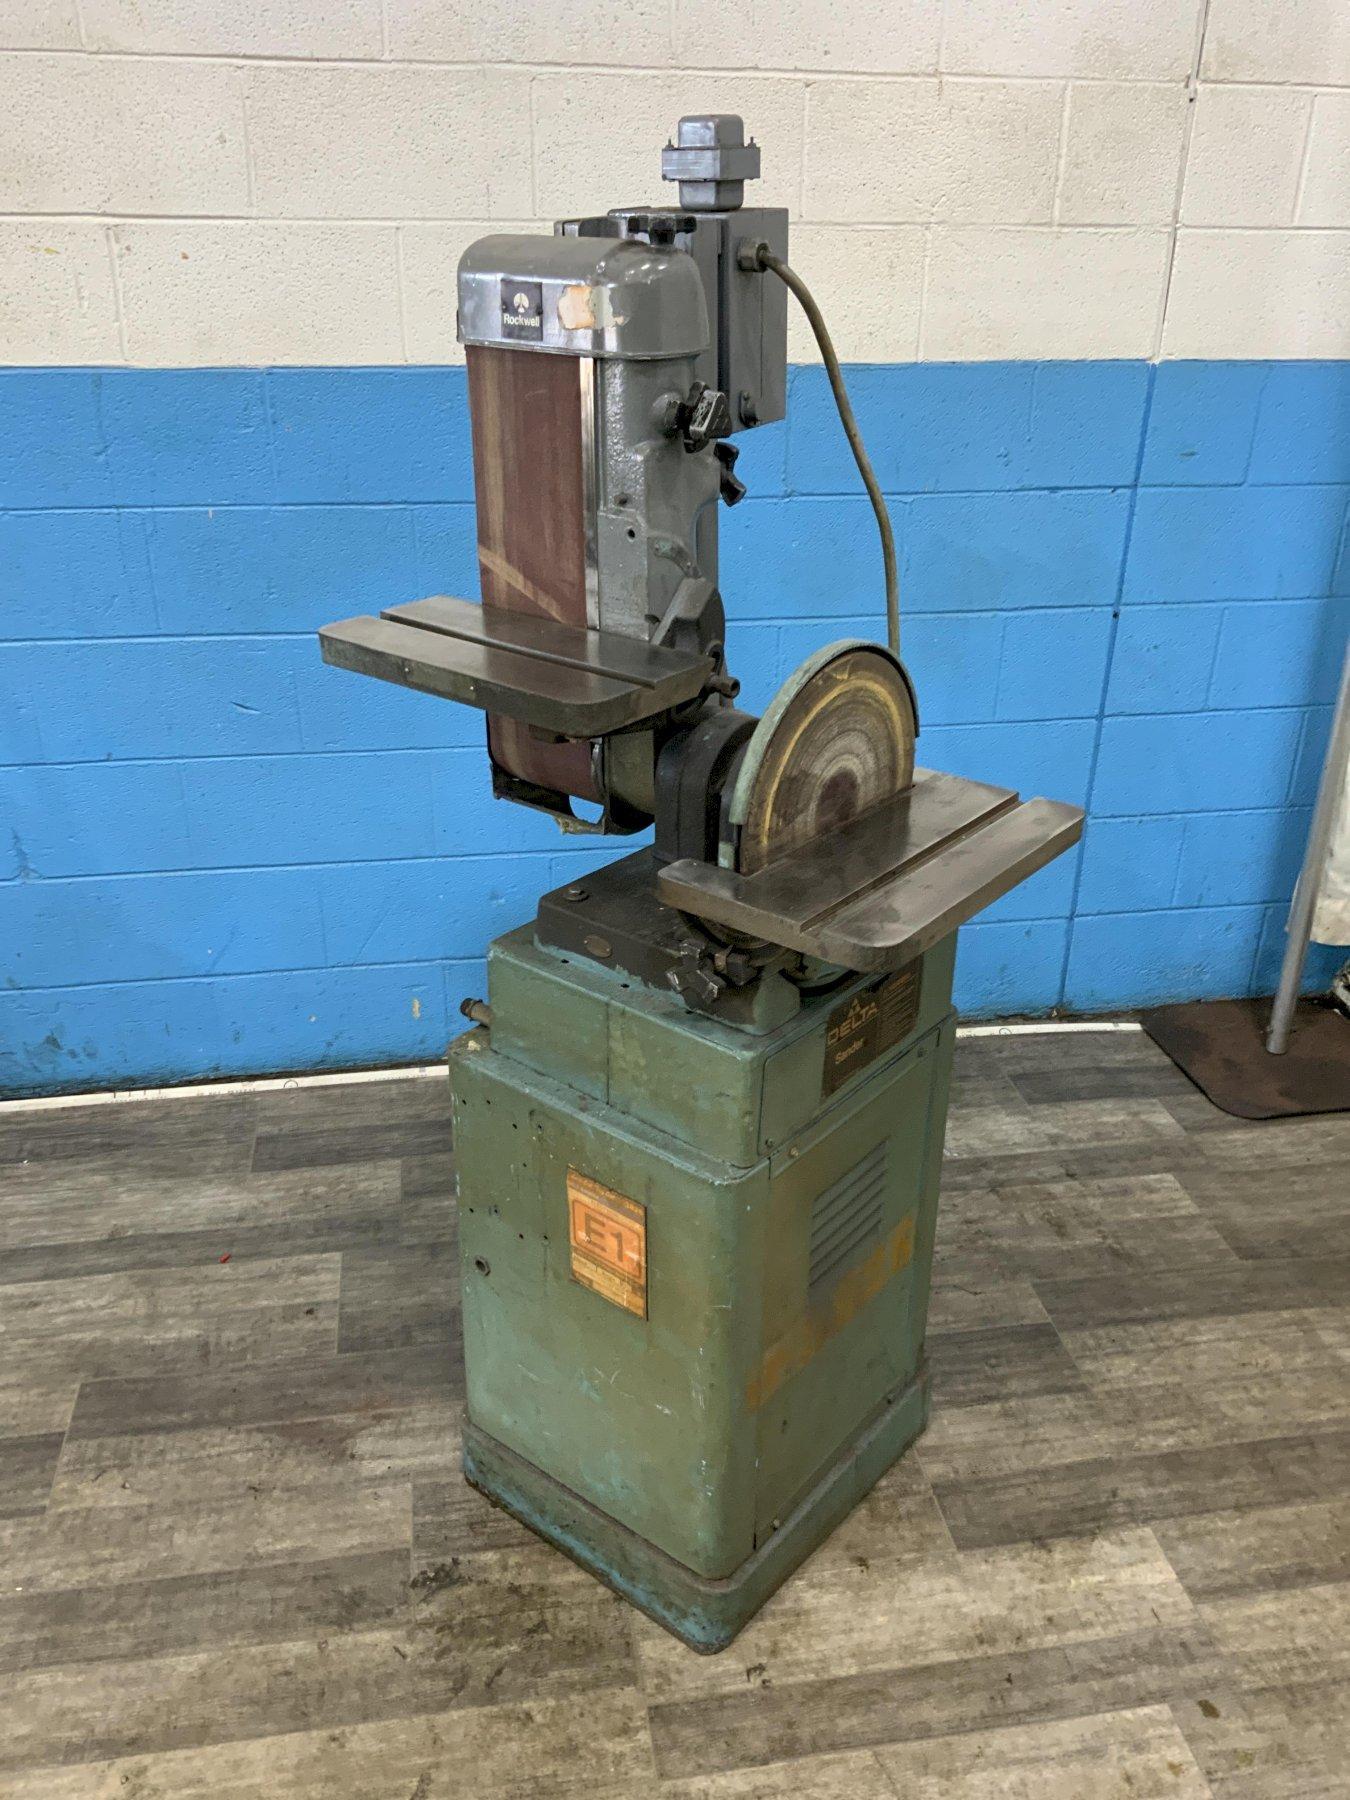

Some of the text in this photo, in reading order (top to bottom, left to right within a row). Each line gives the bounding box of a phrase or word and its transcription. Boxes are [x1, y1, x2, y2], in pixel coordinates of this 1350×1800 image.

[503, 313, 540, 327] Rockwell
[827, 1001, 878, 1046] DELTA
[835, 1038, 864, 1065] Sander
